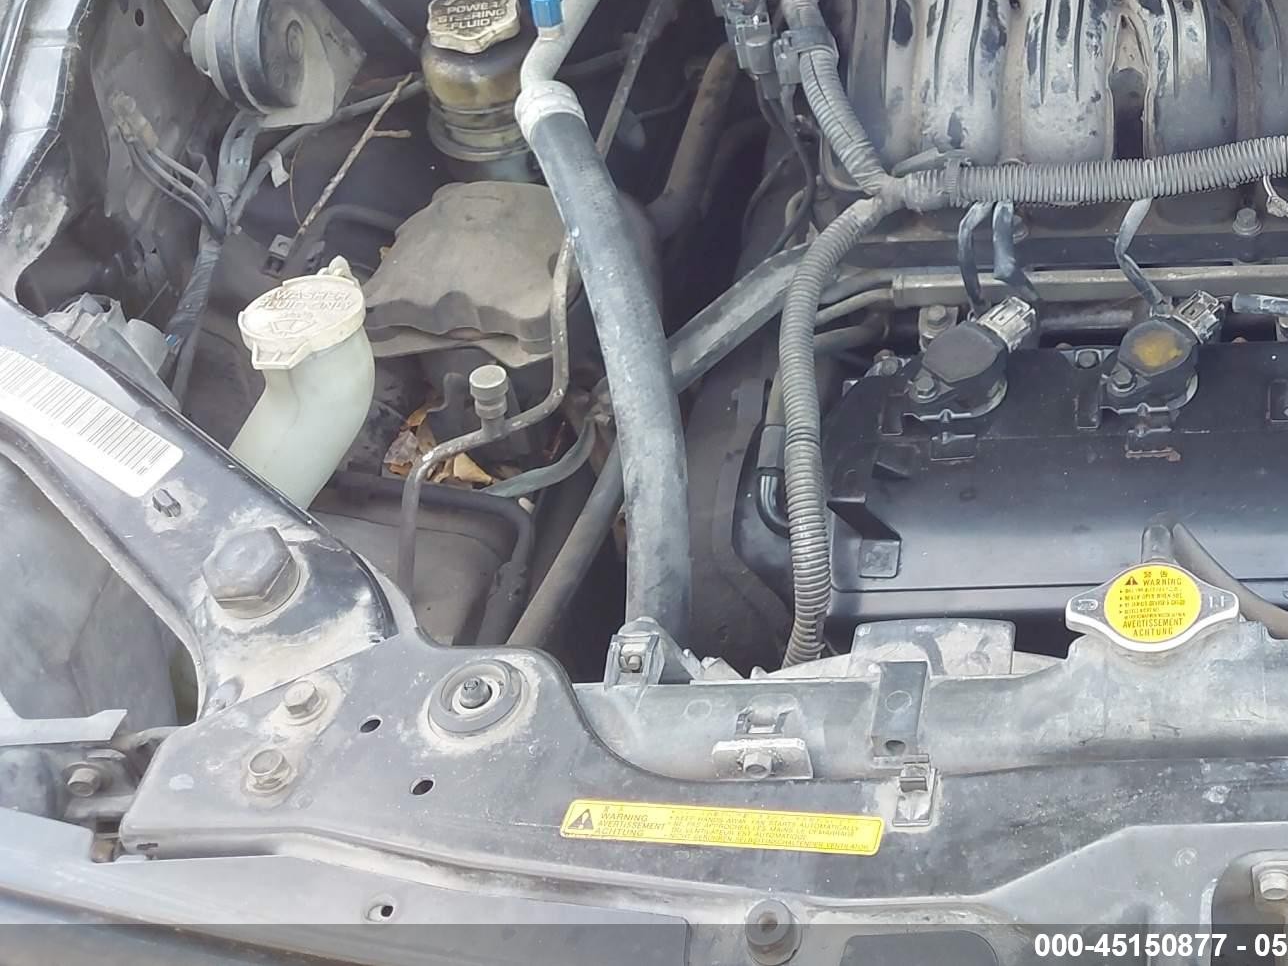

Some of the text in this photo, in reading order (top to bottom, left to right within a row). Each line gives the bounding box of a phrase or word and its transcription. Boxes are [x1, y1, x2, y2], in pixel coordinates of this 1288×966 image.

[450, 19, 490, 30] FLUID
[276, 288, 350, 300] WASHER
[257, 298, 354, 310] FLUID ONLY
[1142, 578, 1182, 586] WARNING
[1209, 595, 1226, 608] 1.1
[1123, 618, 1184, 628] AVERTISSEMENT
[1133, 628, 1173, 636] ACHTUNG
[600, 813, 648, 822] WARNING
[598, 820, 665, 830] AVERTISSEMENT
[594, 828, 645, 837] ACHTUNG
